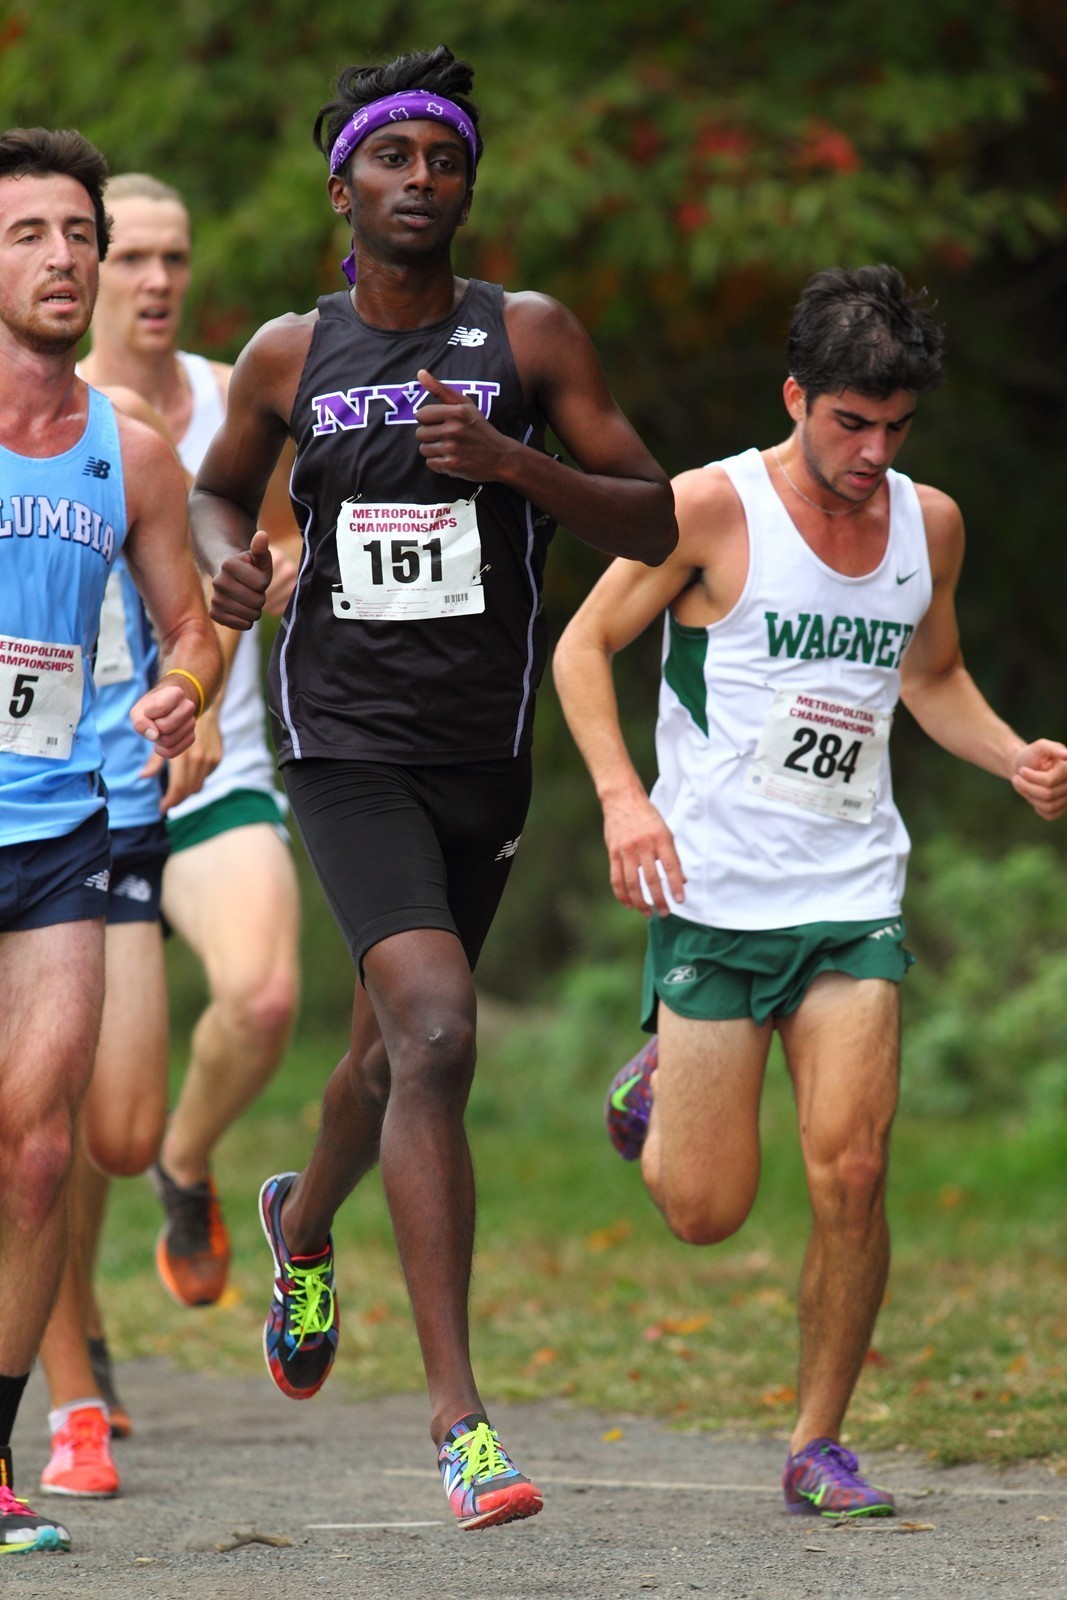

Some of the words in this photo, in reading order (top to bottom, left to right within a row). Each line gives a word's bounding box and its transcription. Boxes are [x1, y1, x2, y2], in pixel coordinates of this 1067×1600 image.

[349, 518, 457, 533] CHAMPIONSHIPS
[352, 507, 451, 519] METROPOLITAN
[363, 537, 443, 585] 151
[8, 674, 39, 719] 5
[796, 695, 875, 723] METROPOLITAN
[783, 727, 863, 784] 284
